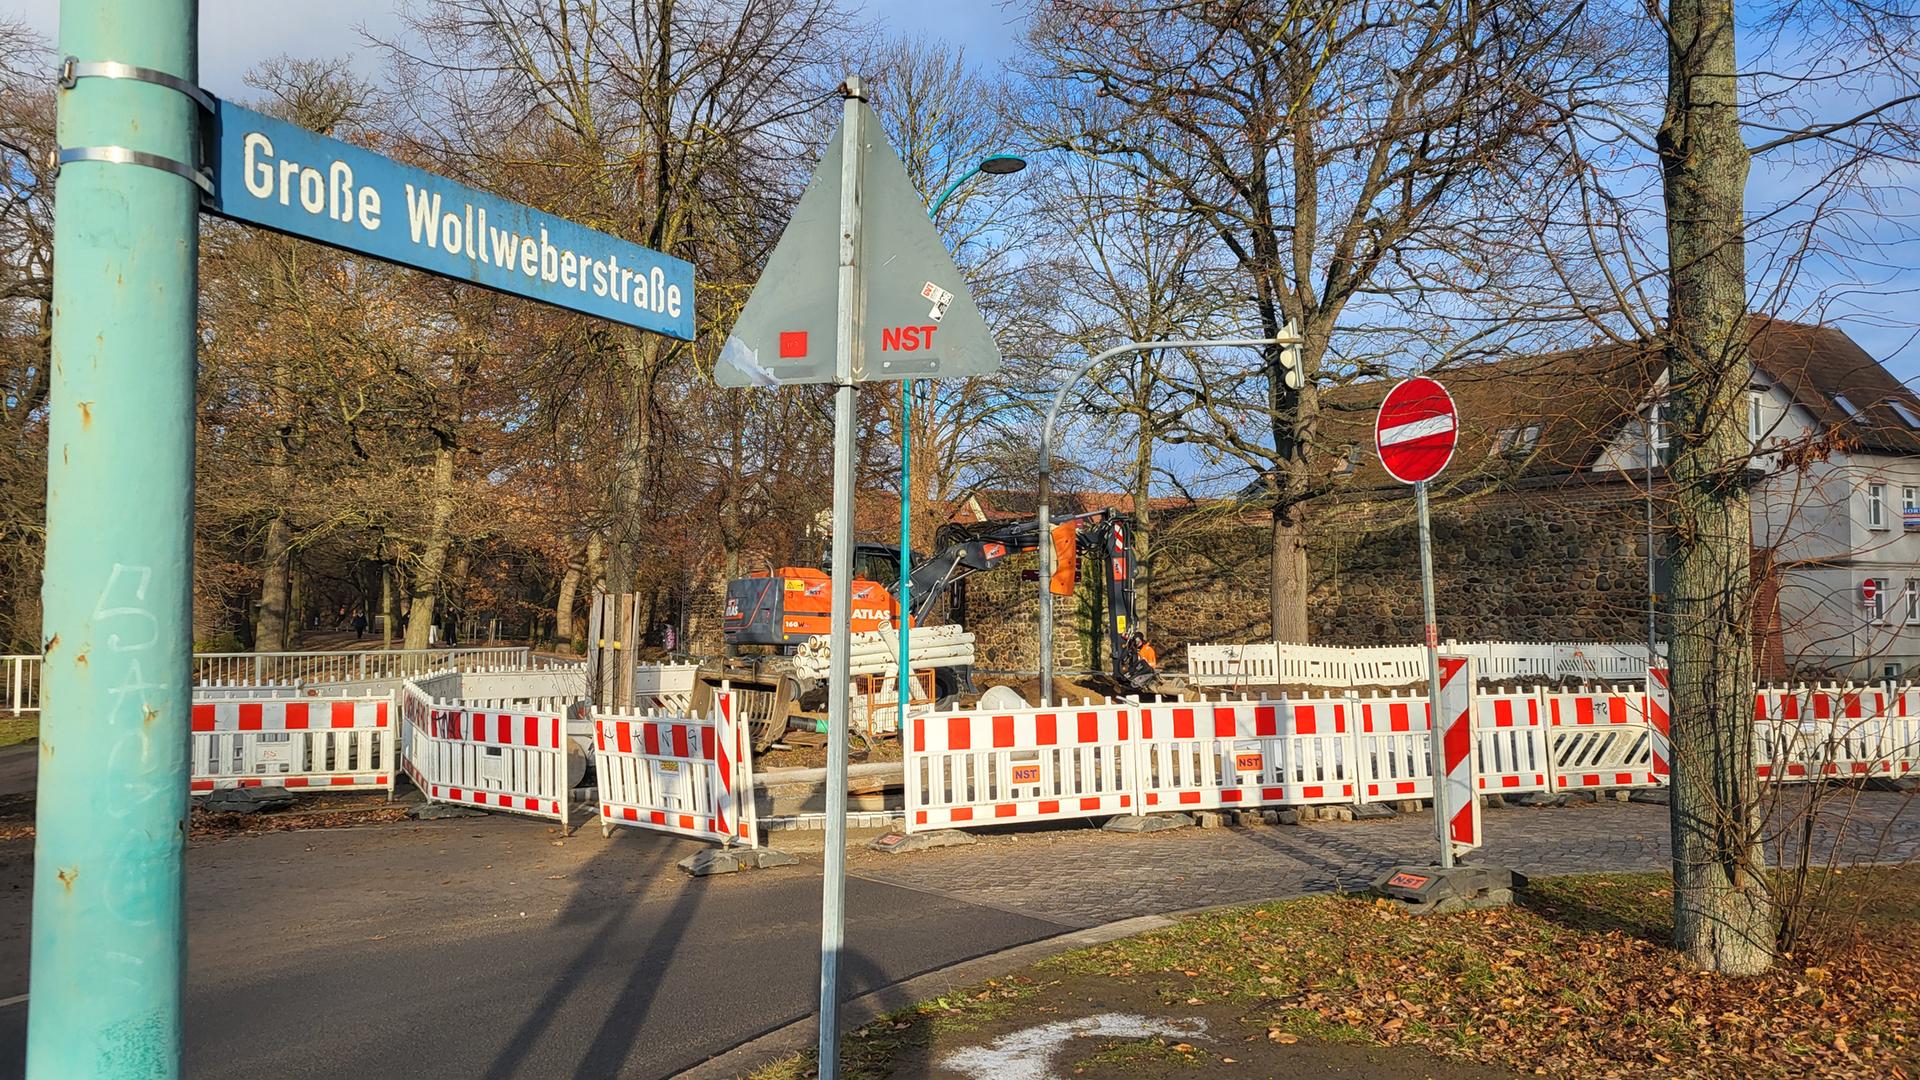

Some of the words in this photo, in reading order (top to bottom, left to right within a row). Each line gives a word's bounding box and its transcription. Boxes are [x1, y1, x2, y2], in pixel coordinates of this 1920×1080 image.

[242, 131, 382, 231] Große
[404, 182, 682, 319] Wollweberstraße
[882, 325, 938, 352] NST
[851, 608, 891, 620] ATLAS
[1239, 758, 1260, 767] NST
[1015, 769, 1038, 780] NST
[1393, 876, 1424, 887] NST
